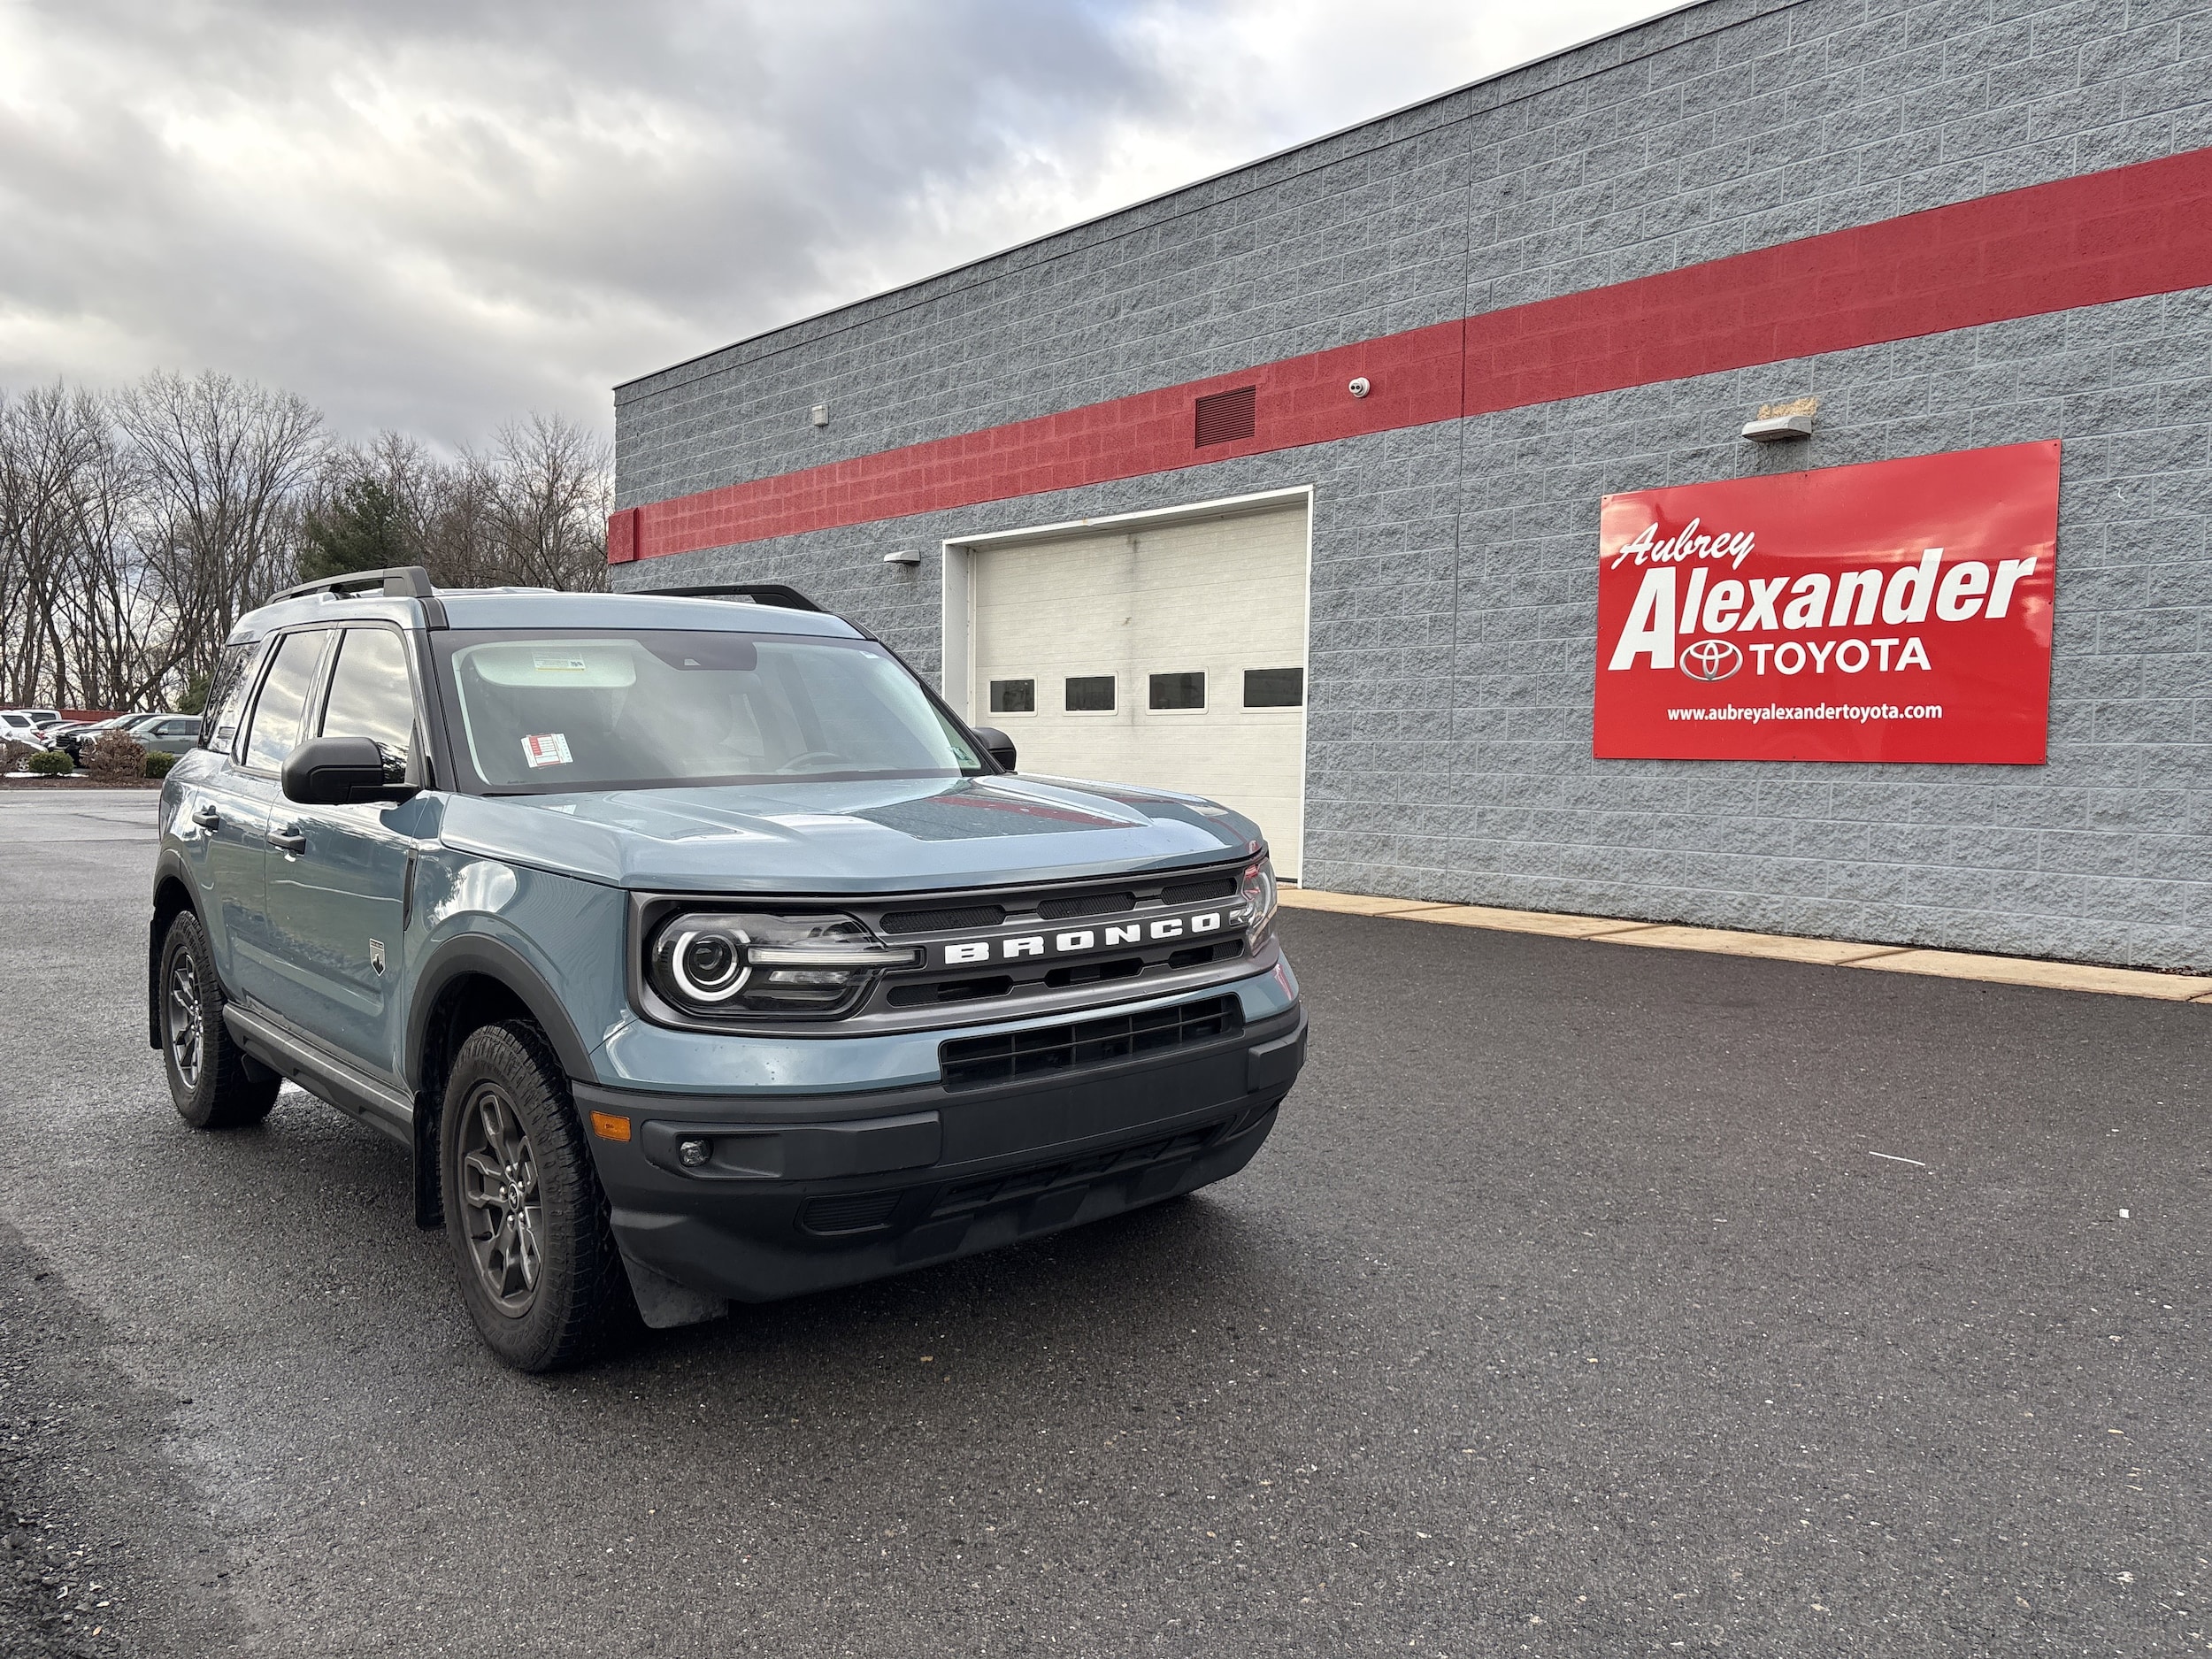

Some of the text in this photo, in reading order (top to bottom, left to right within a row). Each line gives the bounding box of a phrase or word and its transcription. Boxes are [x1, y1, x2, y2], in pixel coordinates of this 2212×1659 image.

[1610, 517, 1755, 571] Aubrey
[1608, 547, 2039, 671] Alexander
[1748, 636, 1932, 675] TOYOTA
[1668, 702, 1943, 725] www.aubreyalexandertoyota.com
[944, 912, 1221, 964] BRONCO
